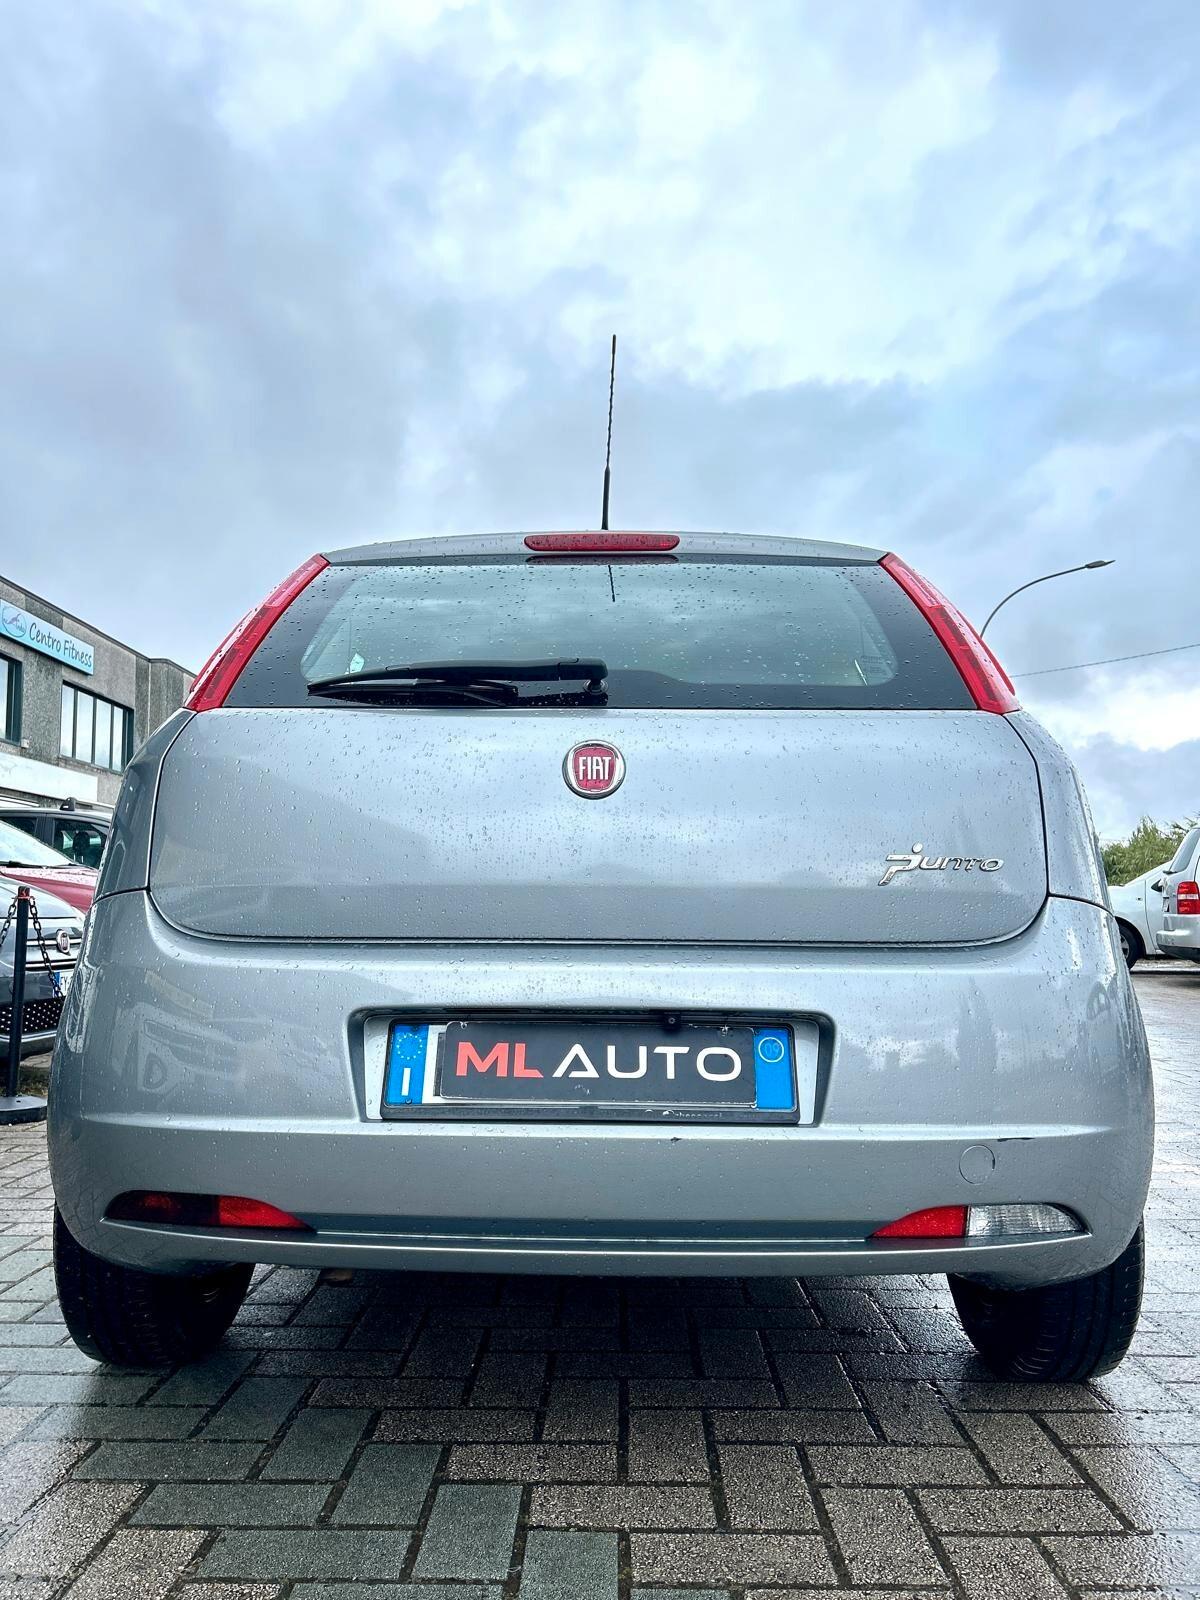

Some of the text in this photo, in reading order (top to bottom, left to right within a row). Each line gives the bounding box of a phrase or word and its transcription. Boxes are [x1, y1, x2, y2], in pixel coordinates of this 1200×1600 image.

[29, 622, 62, 653] Centro
[63, 639, 92, 668] Fitness
[578, 756, 612, 780] FIAT
[455, 1041, 742, 1082] ML AUTO
